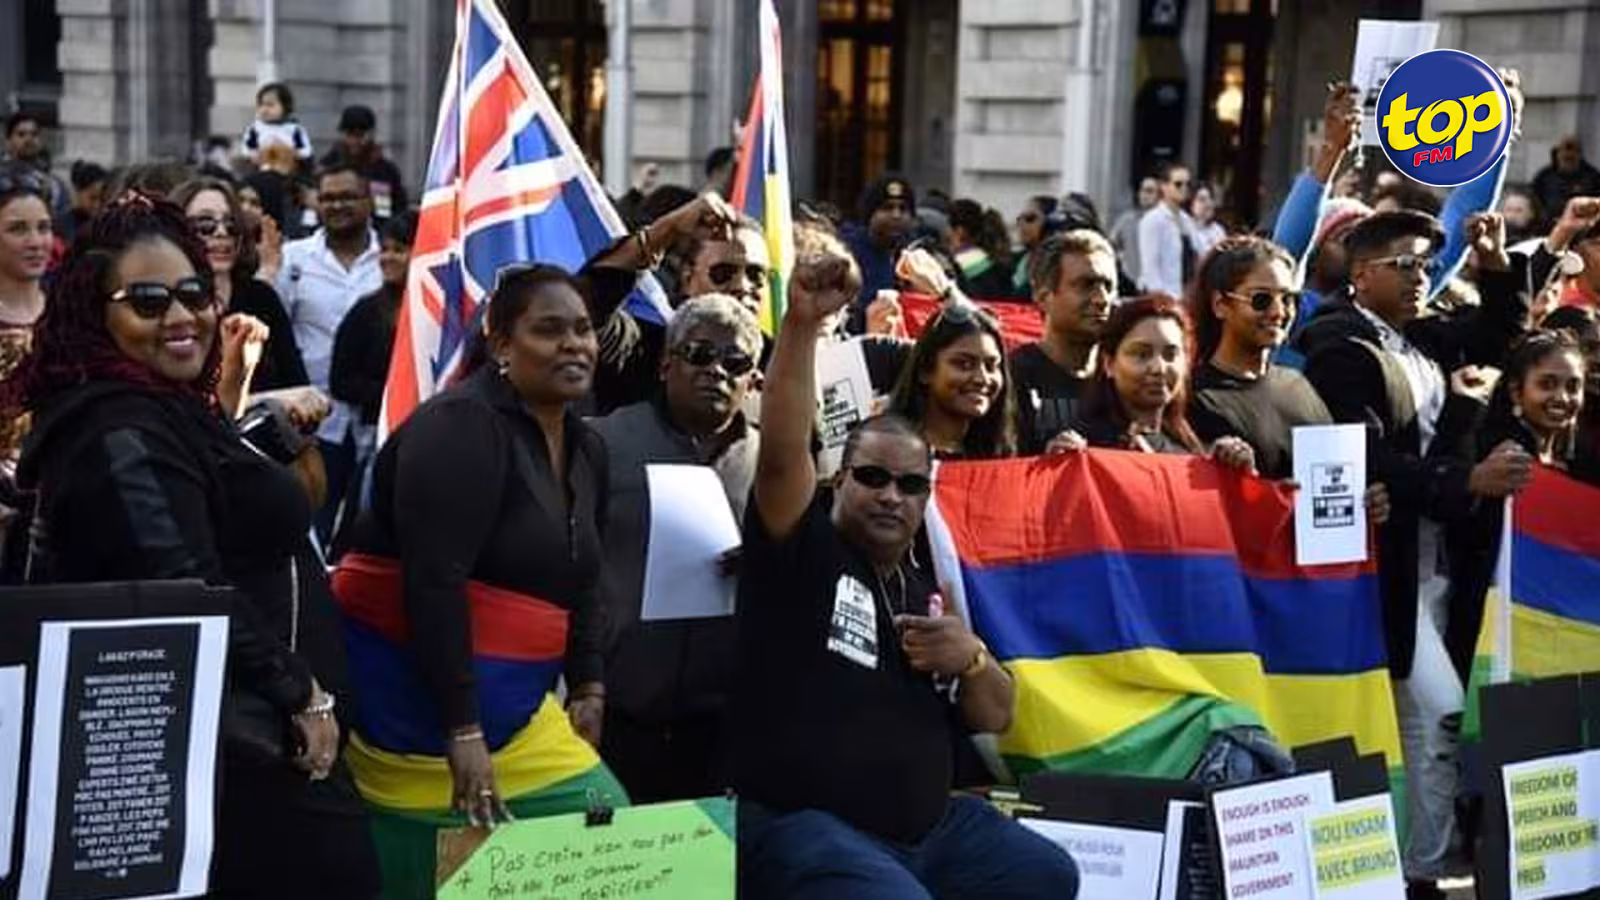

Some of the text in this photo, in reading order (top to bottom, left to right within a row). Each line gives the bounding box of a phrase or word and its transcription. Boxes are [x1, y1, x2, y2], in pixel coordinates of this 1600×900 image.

[1222, 793, 1310, 822] ENOUGH IS ENOUGH
[1551, 799, 1578, 818] AND
[1258, 827, 1273, 840] ON
[1274, 821, 1294, 836] THIS
[1317, 859, 1351, 882] AVEC
[1231, 872, 1294, 898] GOVERNMENT
